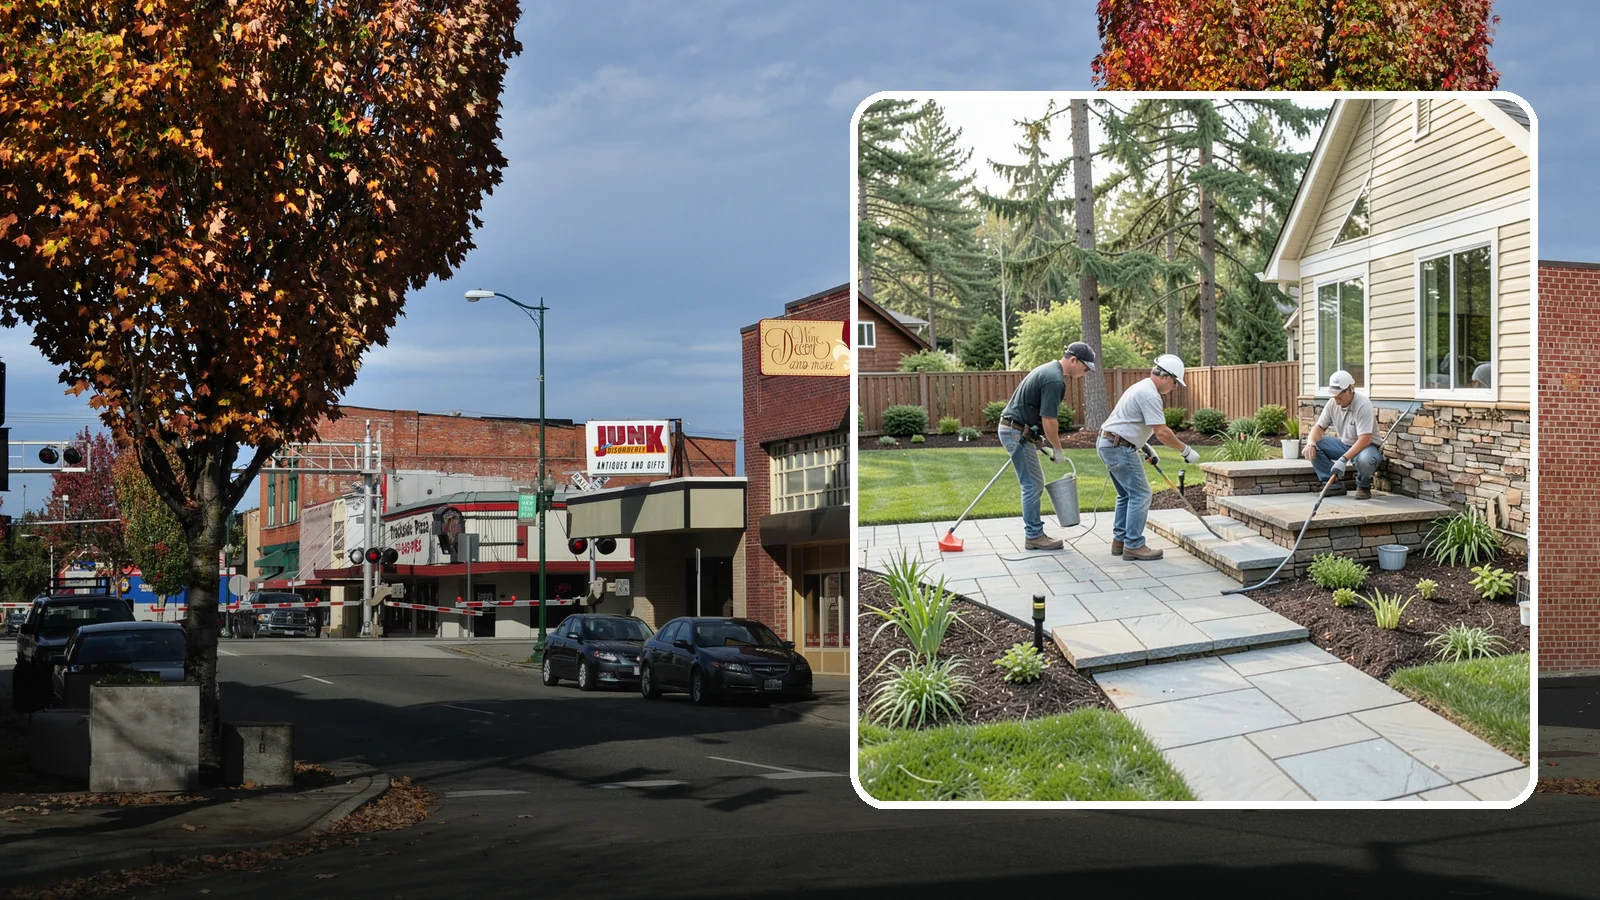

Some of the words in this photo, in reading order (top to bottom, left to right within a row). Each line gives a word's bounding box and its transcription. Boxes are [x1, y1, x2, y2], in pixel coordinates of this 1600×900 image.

[765, 328, 830, 365] Decor
[596, 426, 664, 457] JUNK
[607, 446, 645, 454] DISORDERLY
[597, 461, 627, 470] ANTIQUES
[631, 461, 644, 469] AND
[647, 460, 665, 469] GIFTS
[573, 473, 589, 490] RAIL
[414, 519, 429, 534] Pizza
